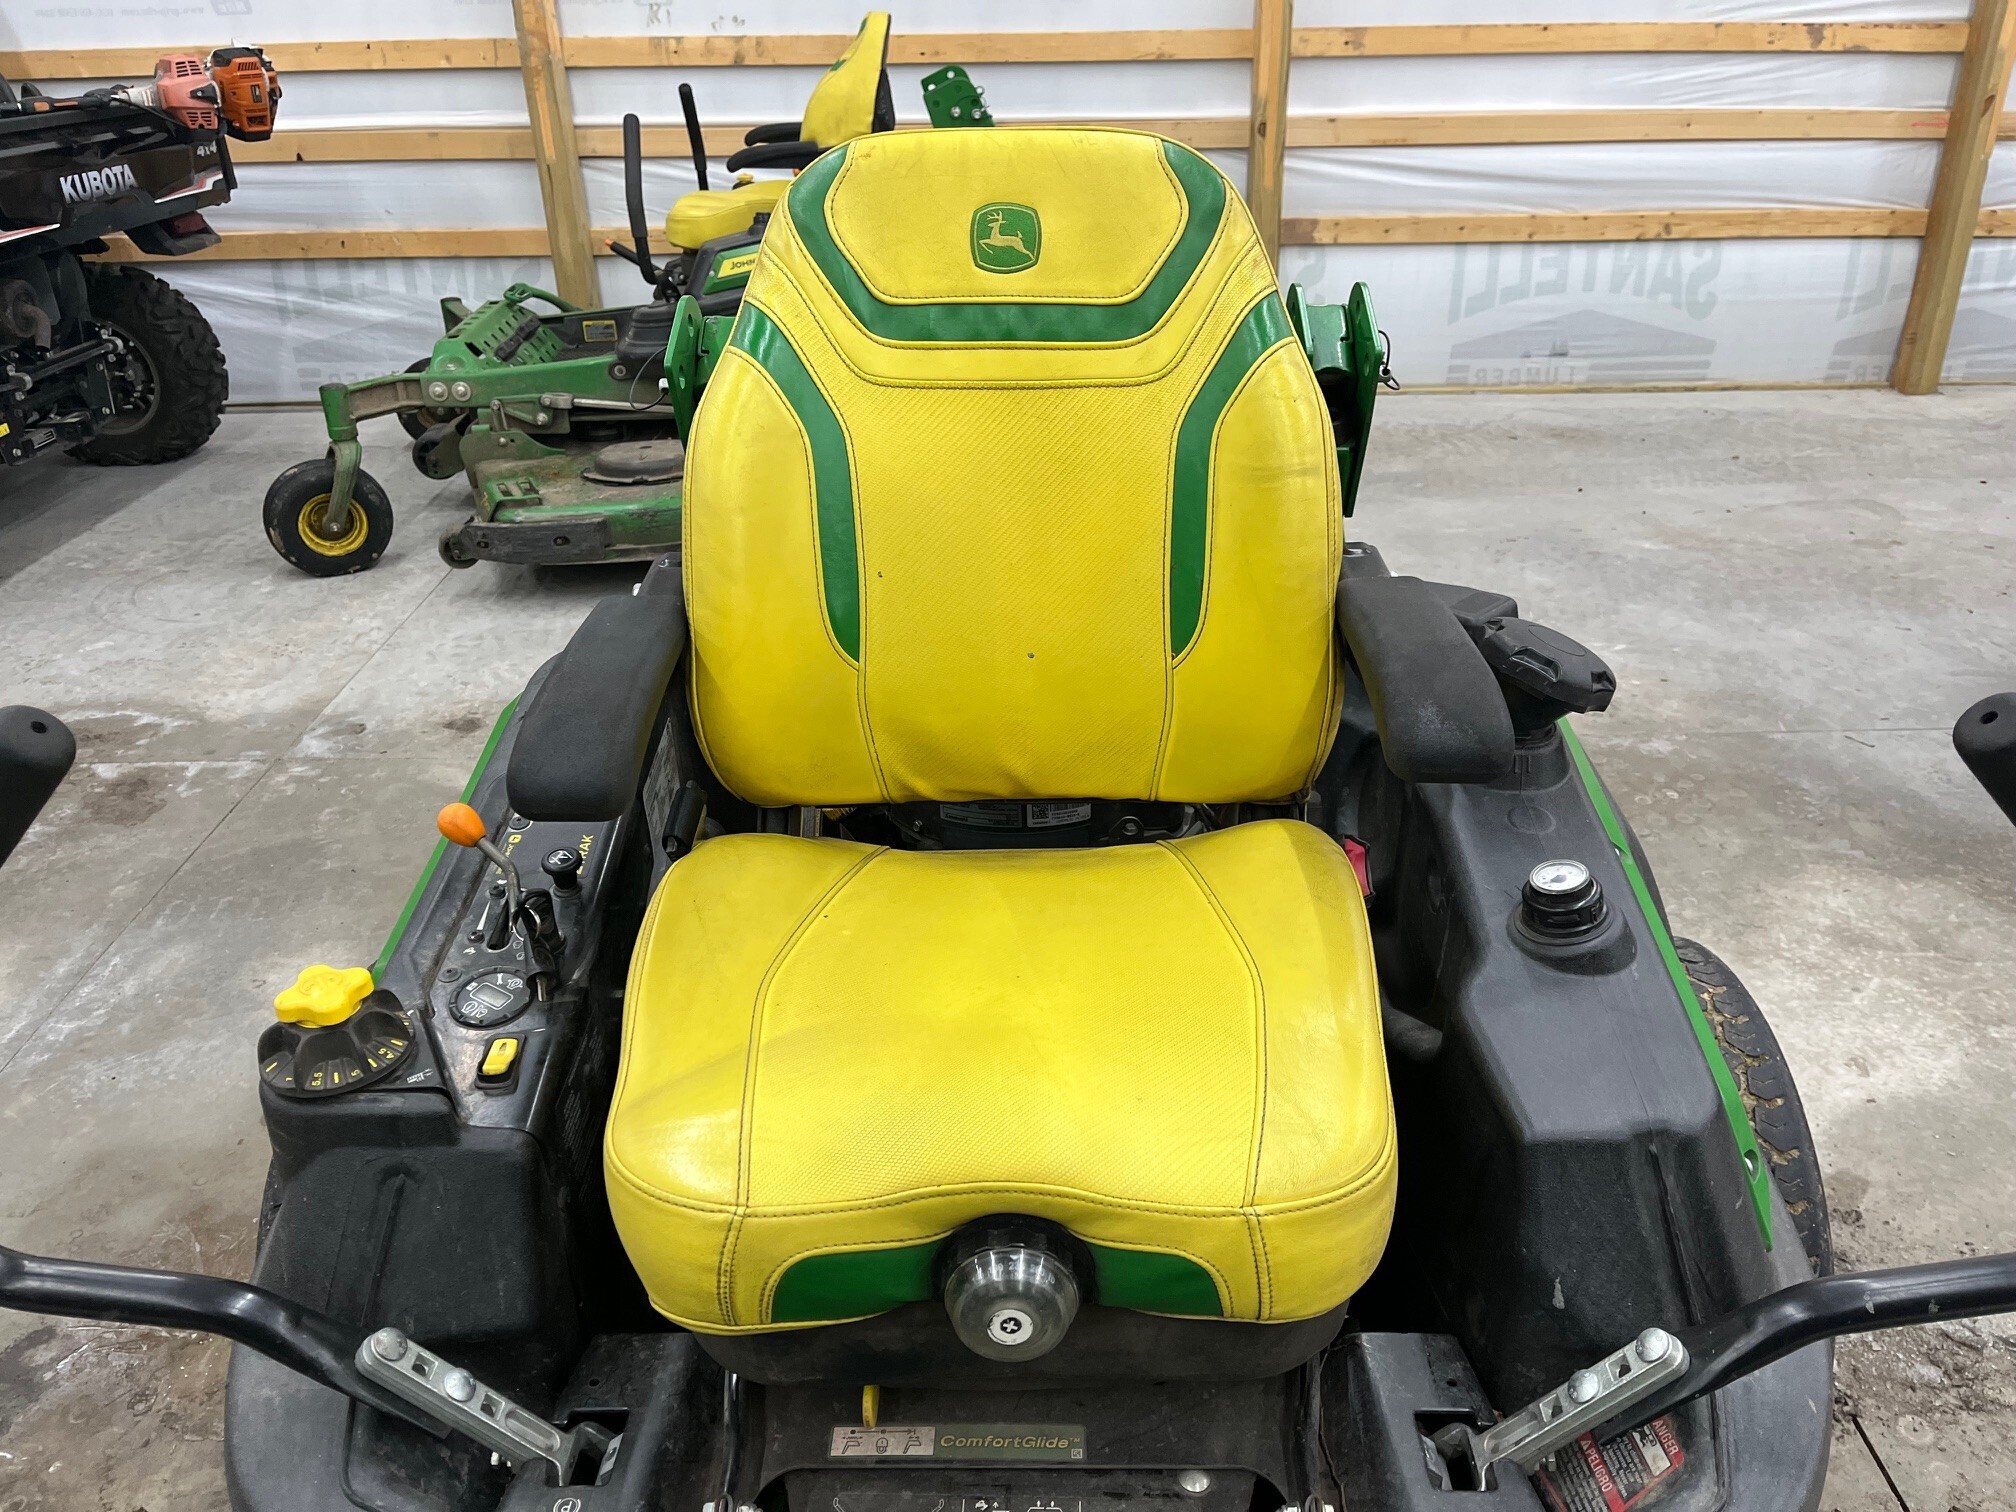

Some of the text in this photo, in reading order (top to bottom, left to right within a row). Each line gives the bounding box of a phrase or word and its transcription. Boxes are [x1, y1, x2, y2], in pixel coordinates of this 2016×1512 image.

[197, 140, 217, 157] 4x4
[60, 164, 138, 203] KUBOTA
[730, 259, 755, 270] JOHN
[378, 1048, 394, 1059] 4.5
[312, 1072, 324, 1087] 5.5
[351, 1069, 360, 1077] 5
[1652, 1419, 1679, 1455] ANGER
[1585, 1449, 1613, 1493] PELIGRO
